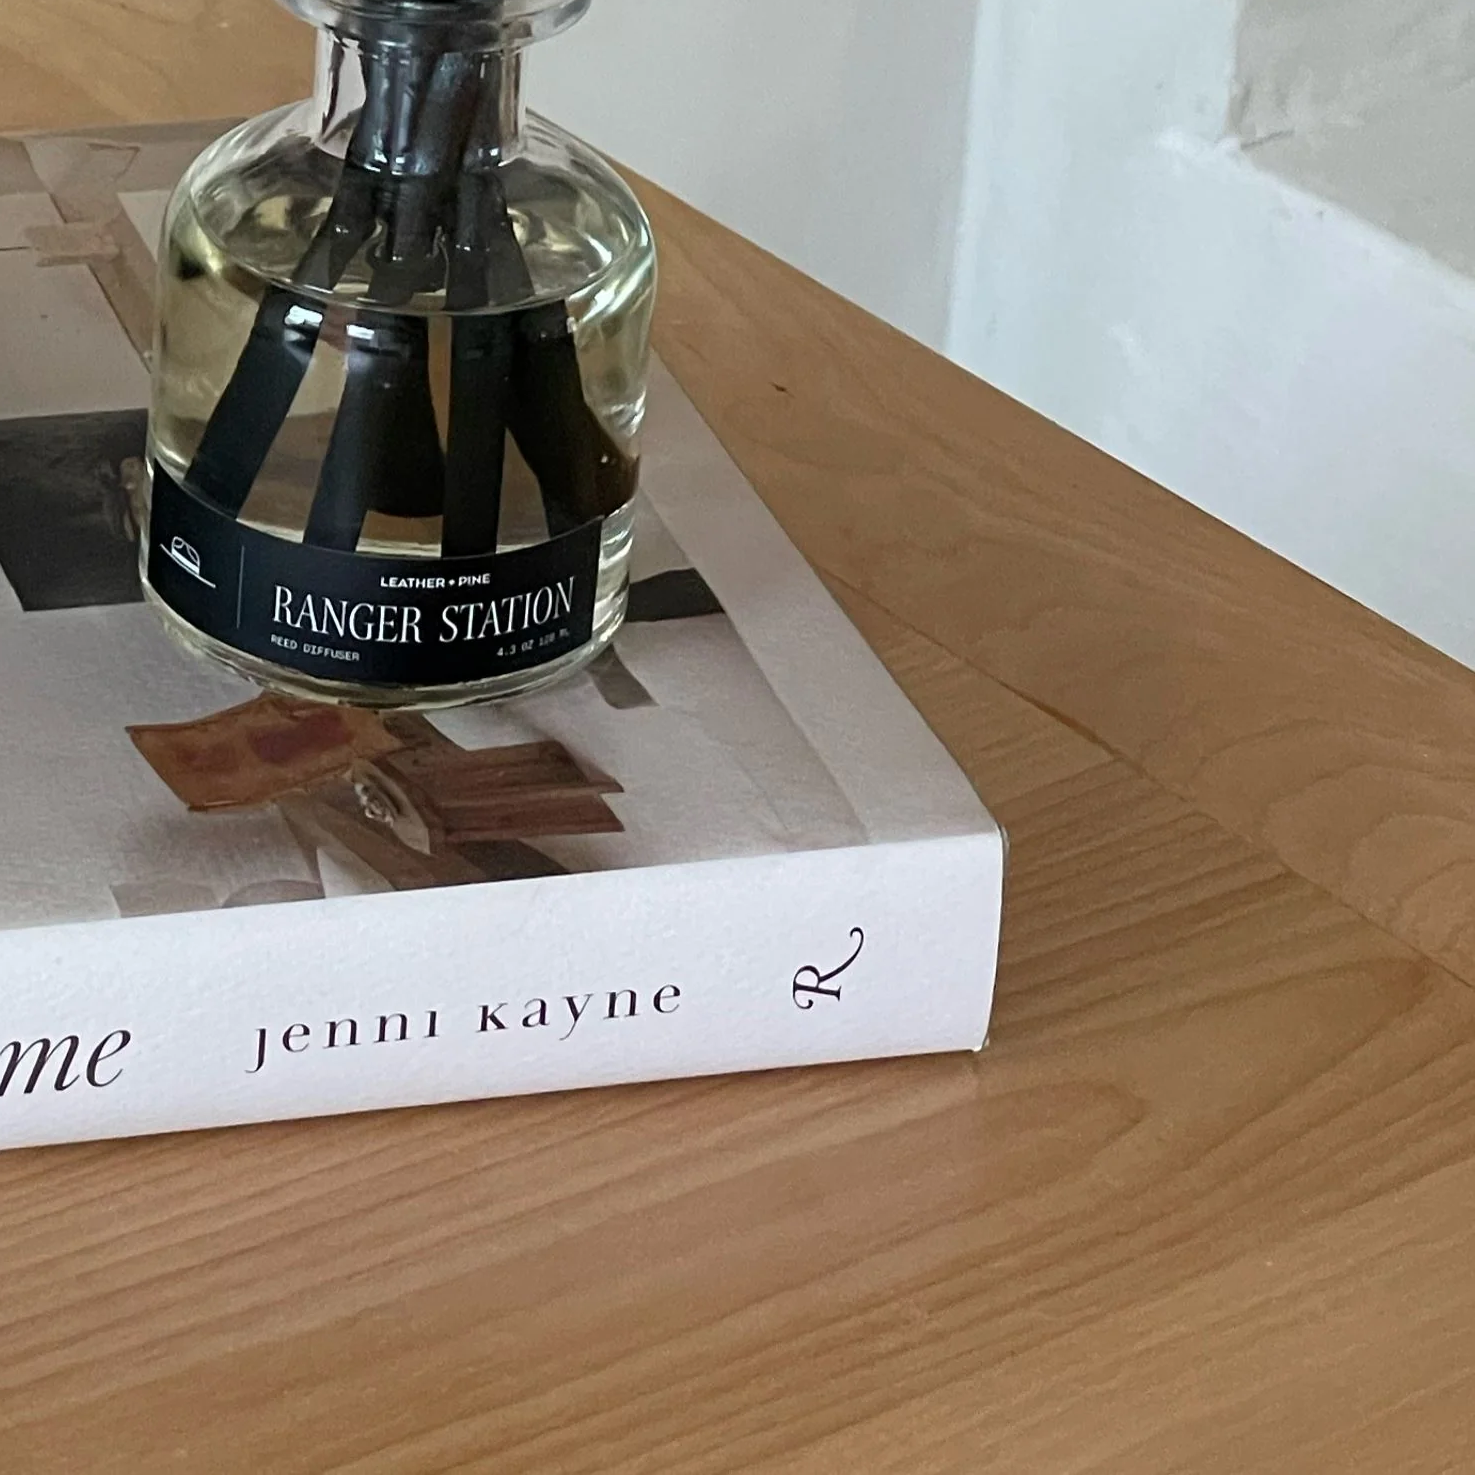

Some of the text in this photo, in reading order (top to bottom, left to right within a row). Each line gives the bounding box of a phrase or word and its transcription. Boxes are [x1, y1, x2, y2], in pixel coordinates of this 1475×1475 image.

[380, 576, 446, 589] LEATHER
[458, 573, 491, 587] PINE
[273, 576, 574, 644] RANGER STATION
[270, 633, 360, 661] REED DIFFUSER
